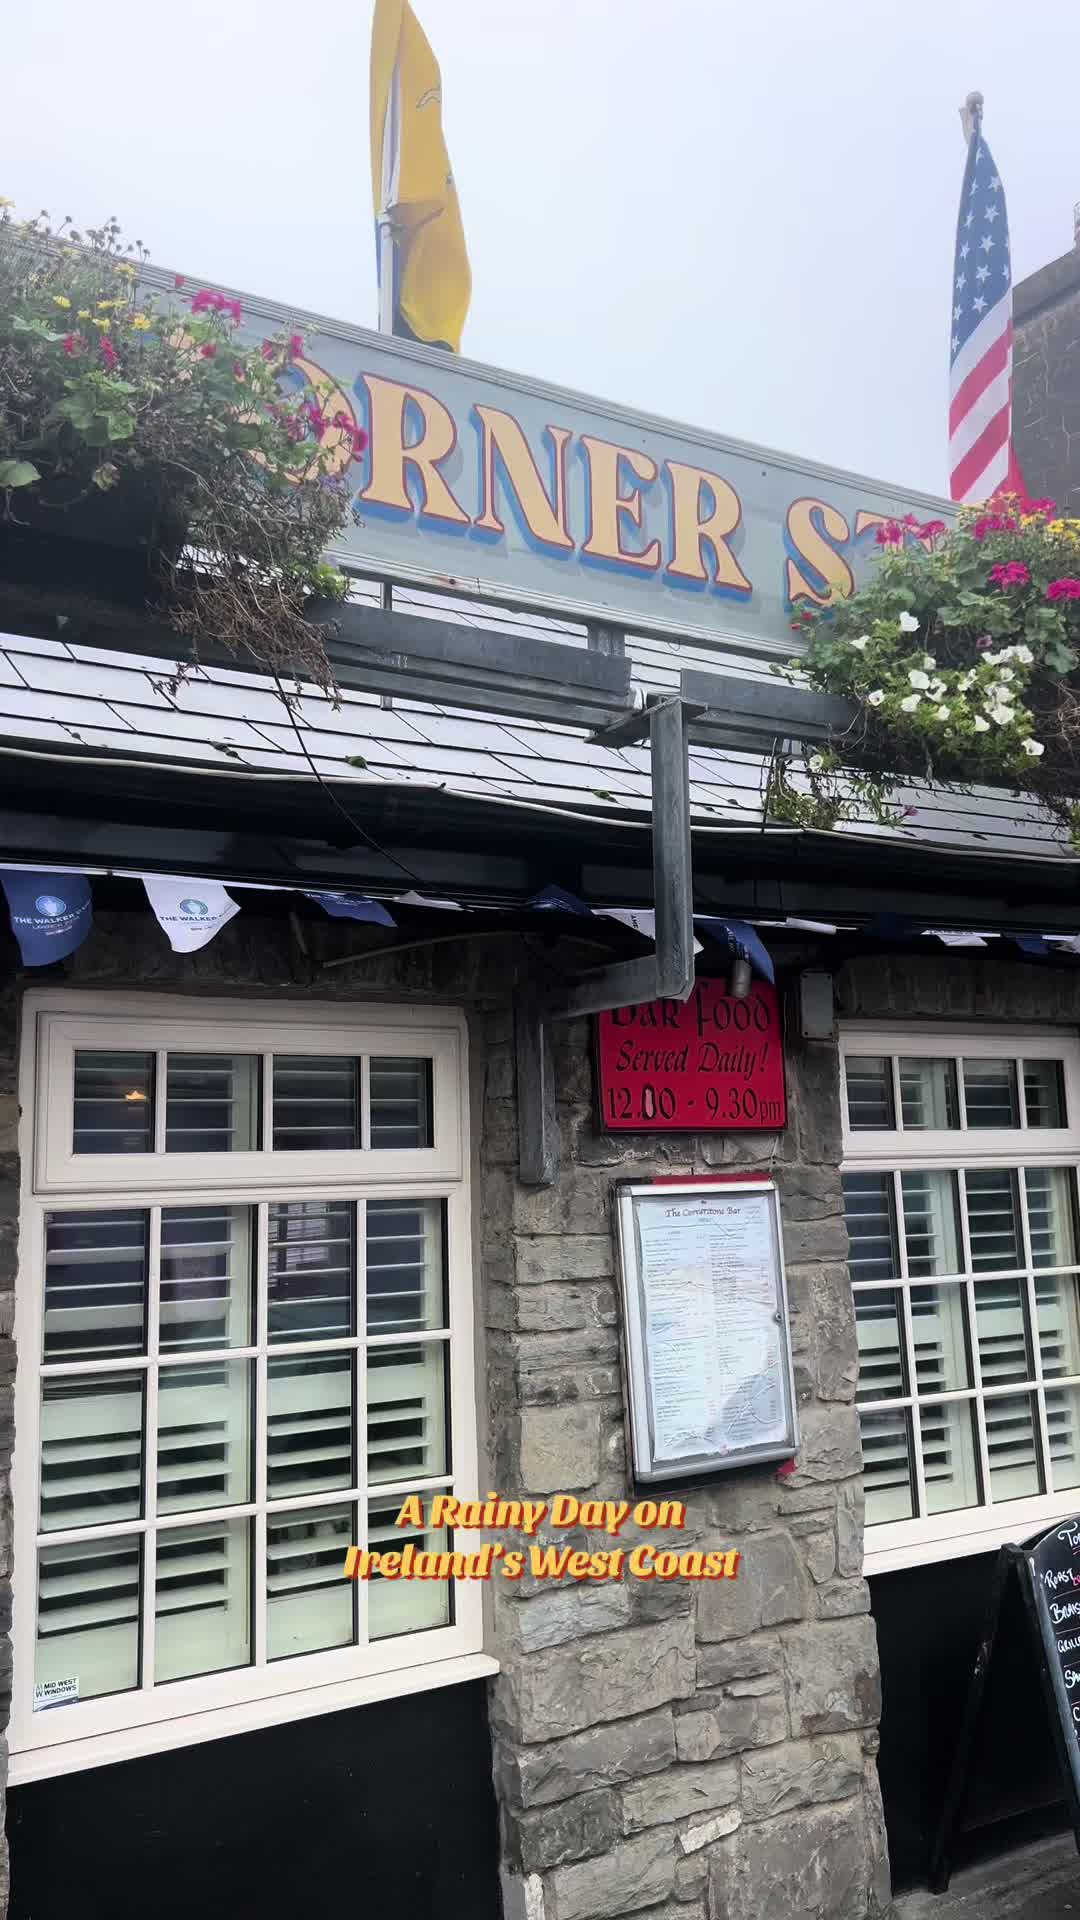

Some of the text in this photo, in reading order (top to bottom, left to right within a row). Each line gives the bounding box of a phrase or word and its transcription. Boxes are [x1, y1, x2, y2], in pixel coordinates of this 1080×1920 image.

[222, 350, 754, 593] ORNER
[14, 916, 32, 924] THE
[33, 914, 75, 924] WALKER
[616, 1040, 769, 1080] Served Daily!
[44, 1685, 76, 1695] WINDOWS
